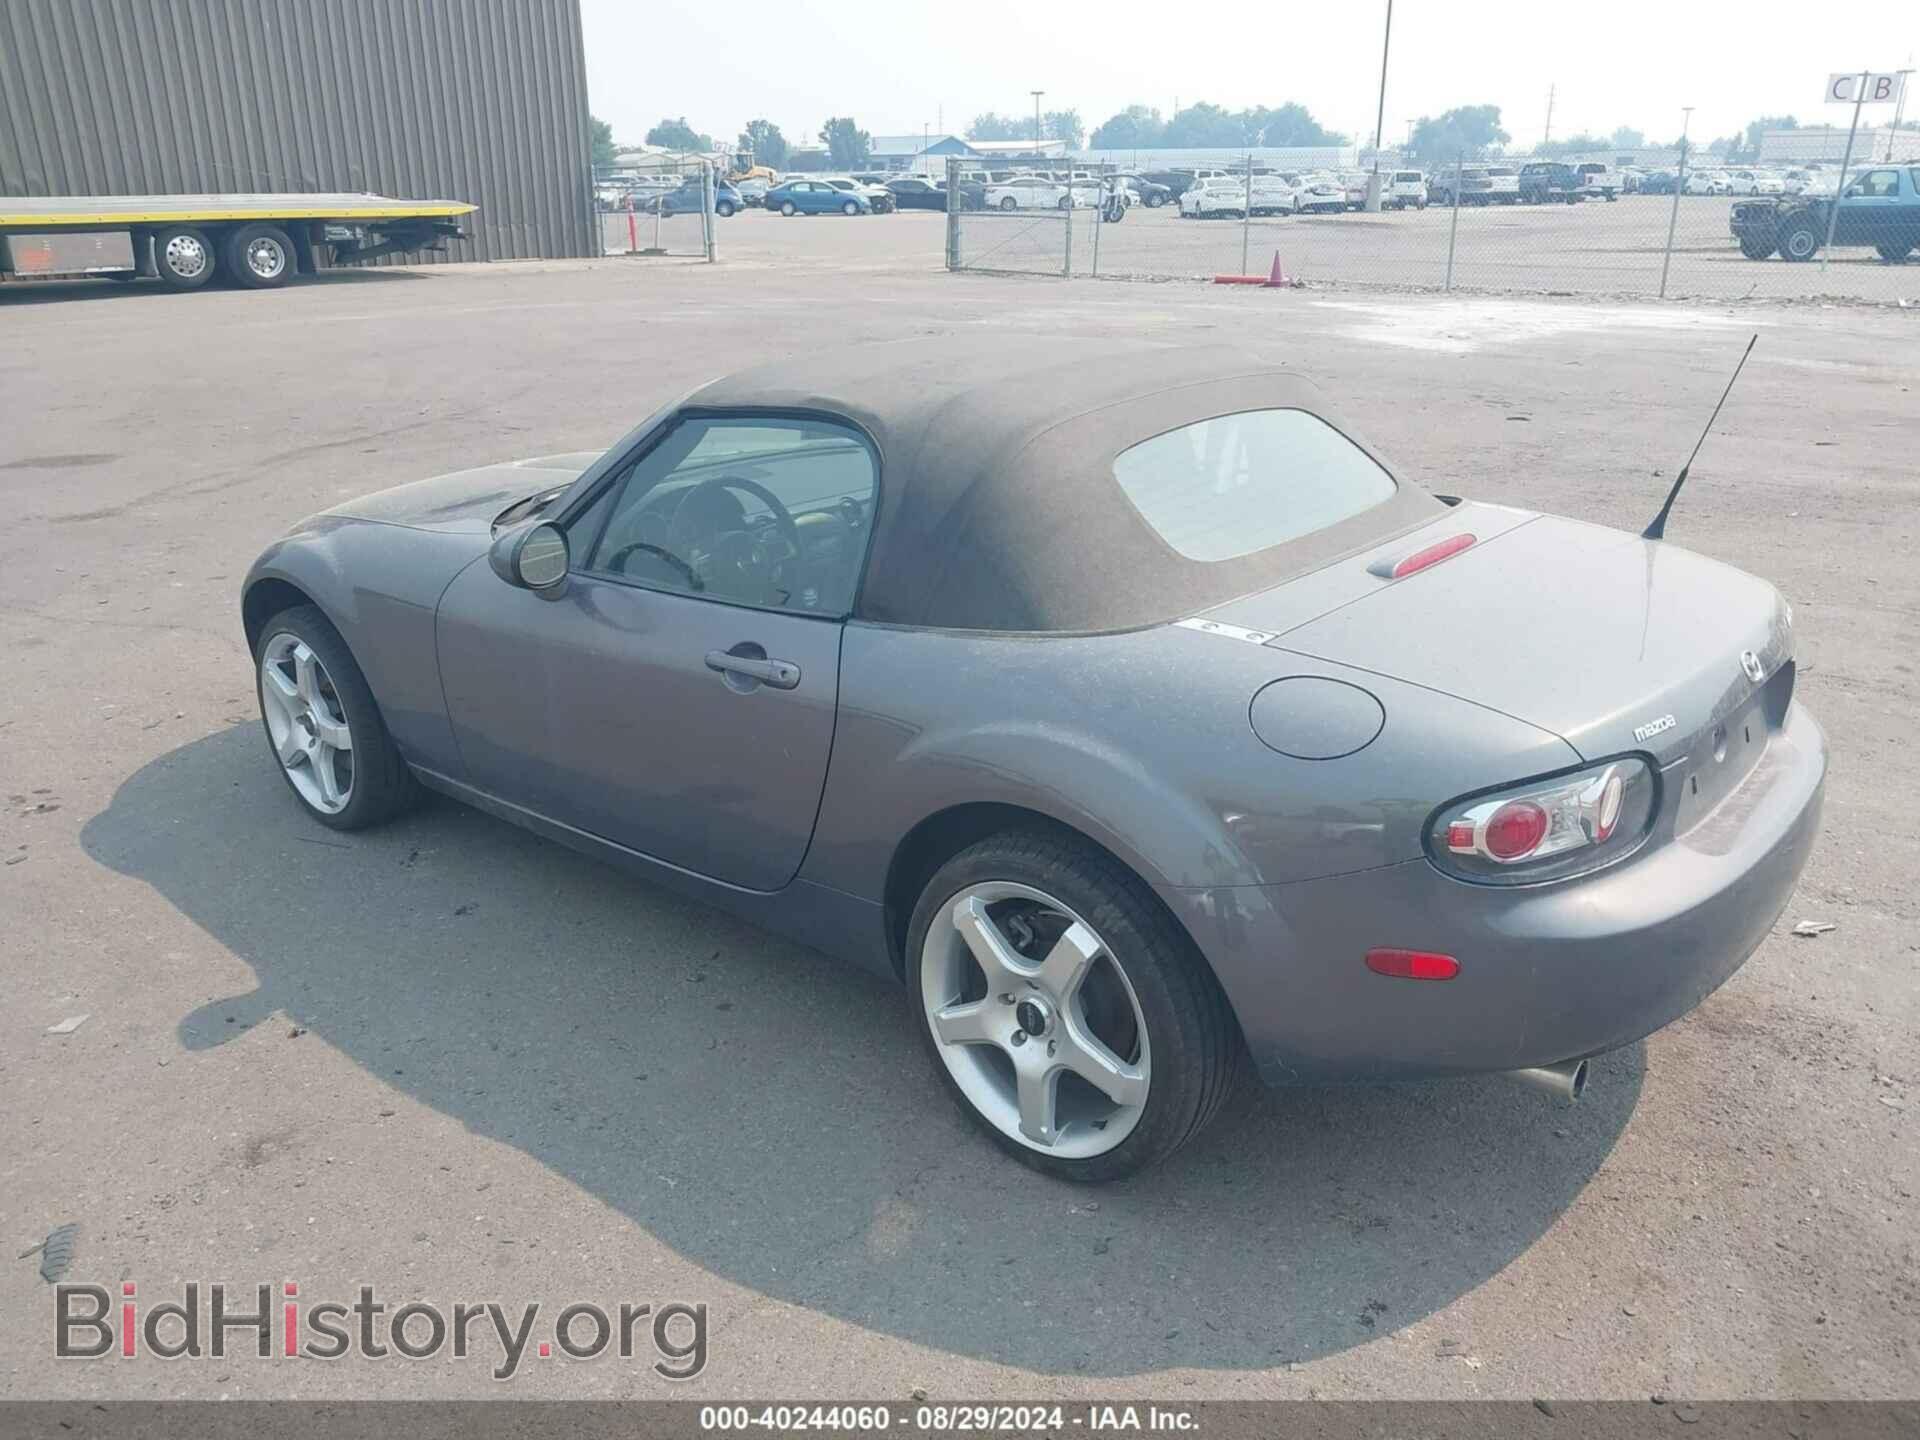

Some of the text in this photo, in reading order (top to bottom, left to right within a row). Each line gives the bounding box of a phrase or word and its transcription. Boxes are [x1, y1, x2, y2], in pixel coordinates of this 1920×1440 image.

[1833, 77, 1851, 100] C
[1874, 77, 1892, 100] B
[1633, 714, 1677, 744] mazda
